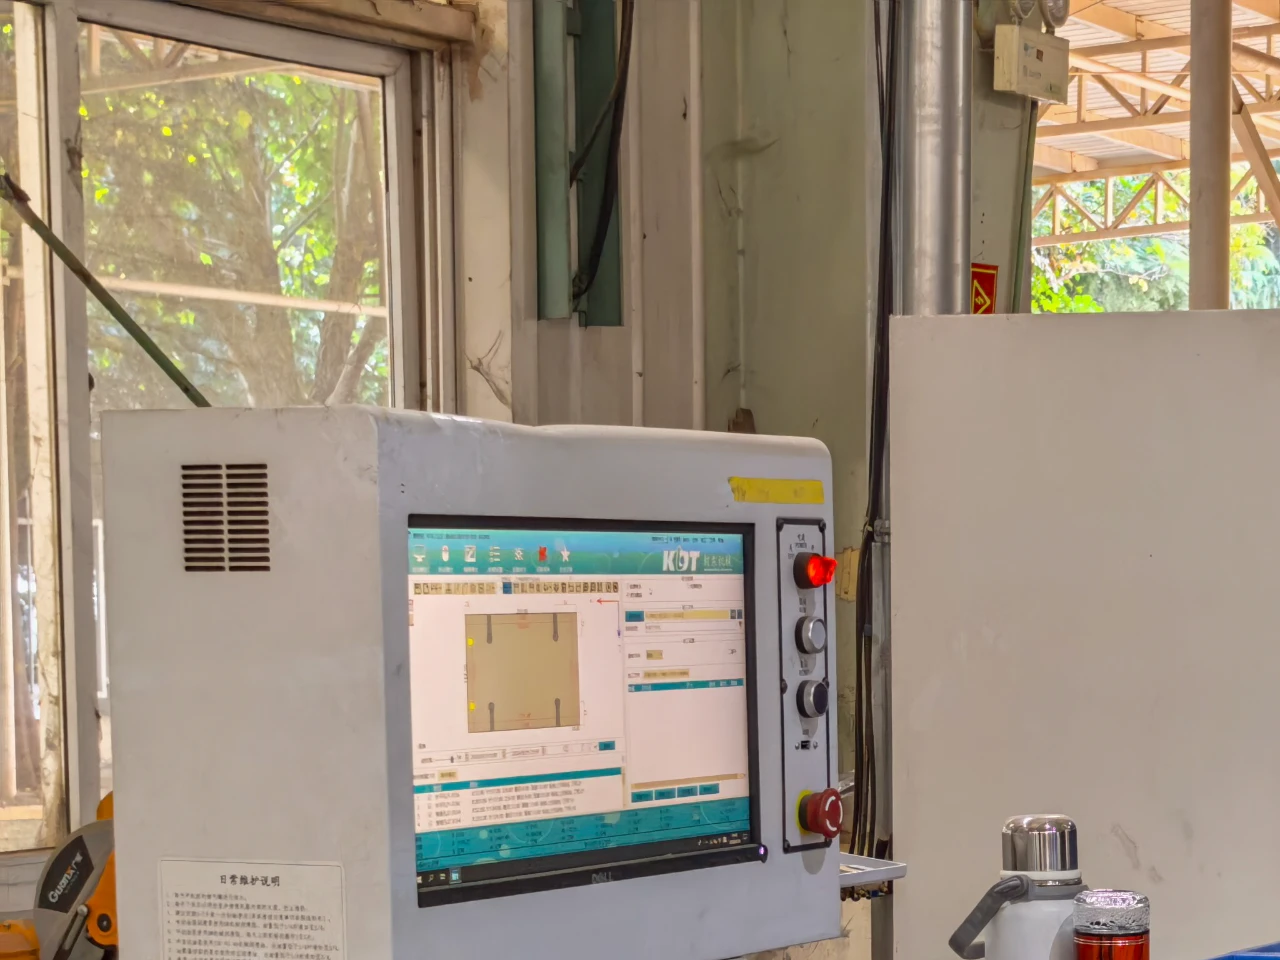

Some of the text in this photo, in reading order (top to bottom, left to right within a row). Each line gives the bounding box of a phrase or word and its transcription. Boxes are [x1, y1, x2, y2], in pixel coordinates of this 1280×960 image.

[220, 874, 280, 887] 日常维护说明
